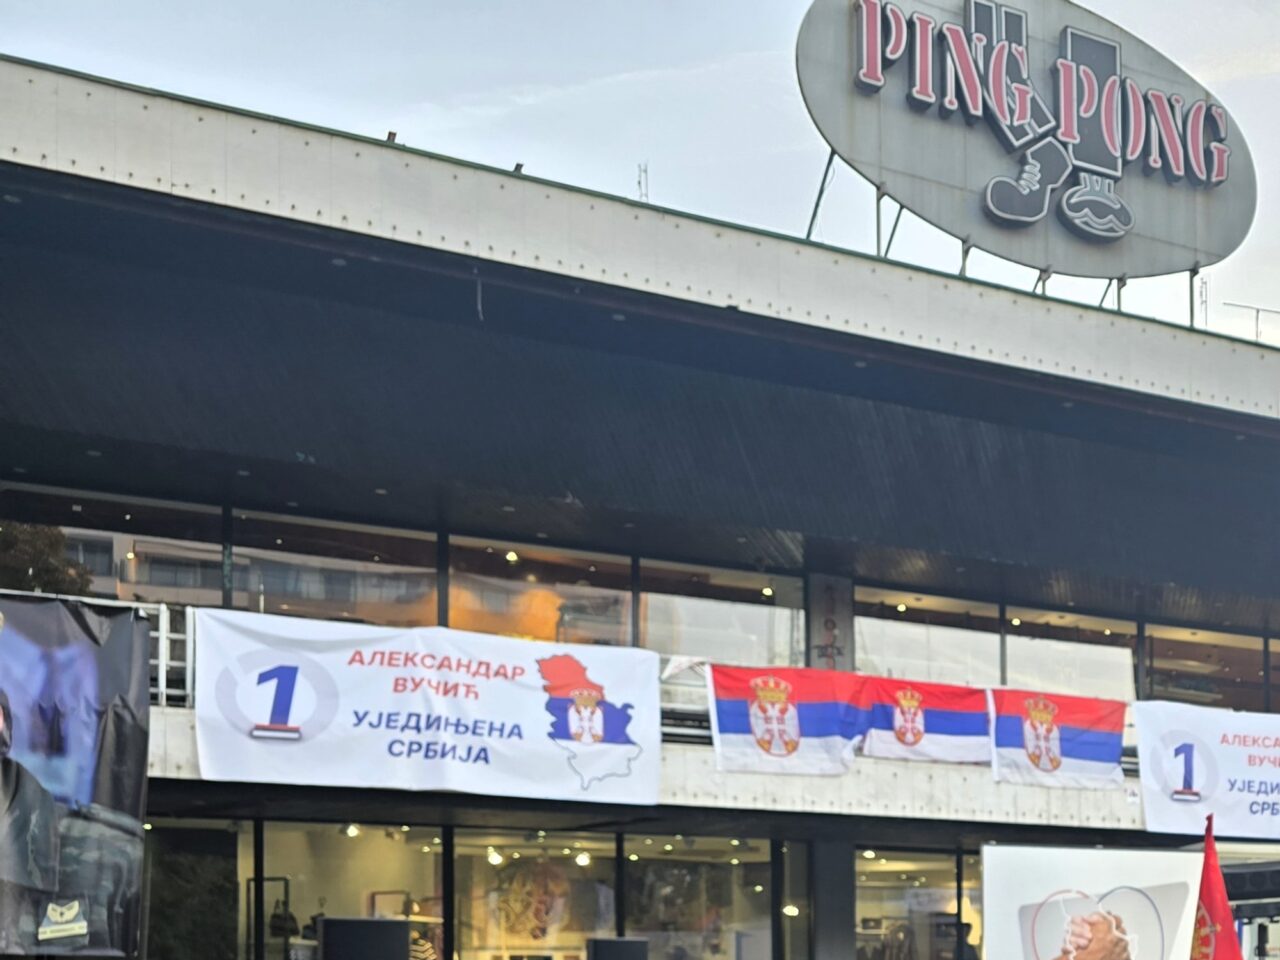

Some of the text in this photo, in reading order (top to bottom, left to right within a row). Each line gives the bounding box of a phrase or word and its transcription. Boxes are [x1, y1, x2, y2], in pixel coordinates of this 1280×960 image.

[855, 0, 1231, 183] PING PONG
[347, 649, 526, 681] АЛЕКСАНДАР
[252, 664, 301, 740] 1
[392, 677, 479, 700] ВУЧИЋ
[352, 710, 524, 740] УЈЕДИЊЕНА
[387, 739, 490, 765] СРБИЈА
[1172, 743, 1202, 801] 1
